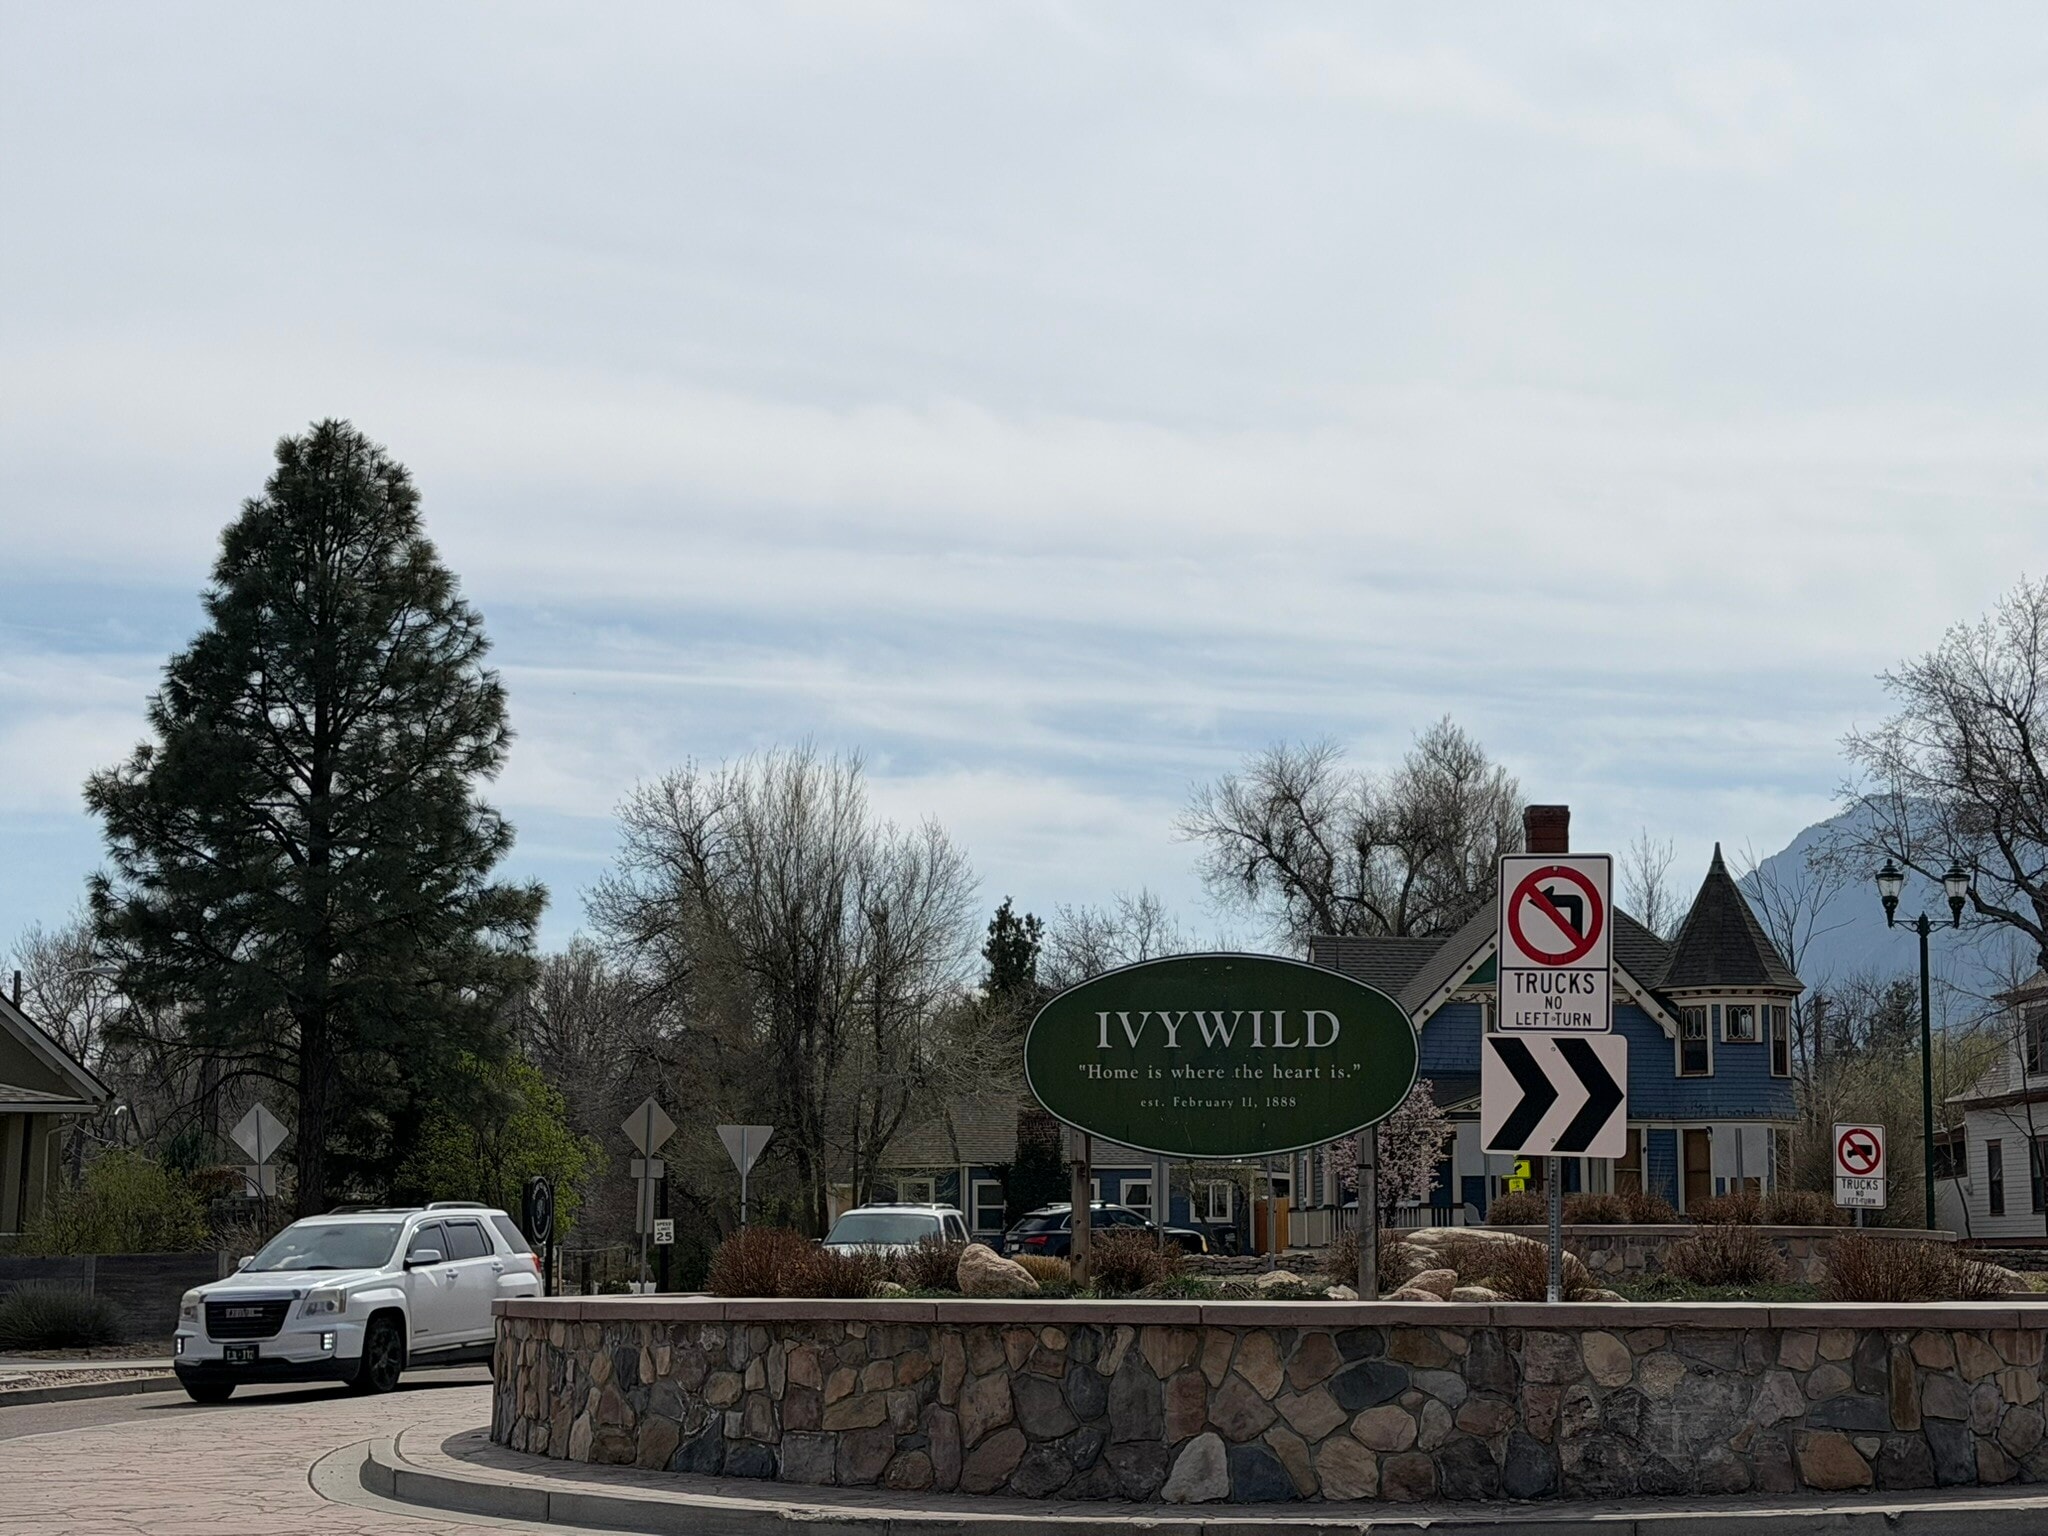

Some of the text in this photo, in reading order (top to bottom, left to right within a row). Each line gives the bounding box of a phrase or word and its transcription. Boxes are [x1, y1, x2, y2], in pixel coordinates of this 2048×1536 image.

[1514, 972, 1595, 994] TRUCKS
[1544, 995, 1563, 1010] NO
[1515, 1011, 1592, 1027] LEFT TURN
[1095, 1010, 1341, 1049] IVYWILD
[1148, 1064, 1162, 1079] is
[1171, 1063, 1225, 1079] where
[1234, 1063, 1264, 1079] the
[1272, 1063, 1320, 1079] heart
[1140, 1096, 1297, 1109] est. February 11, 1888
[1841, 1178, 1879, 1190] TRUCKS
[1844, 1197, 1858, 1205] LEFT
[656, 1231, 672, 1242] 25
